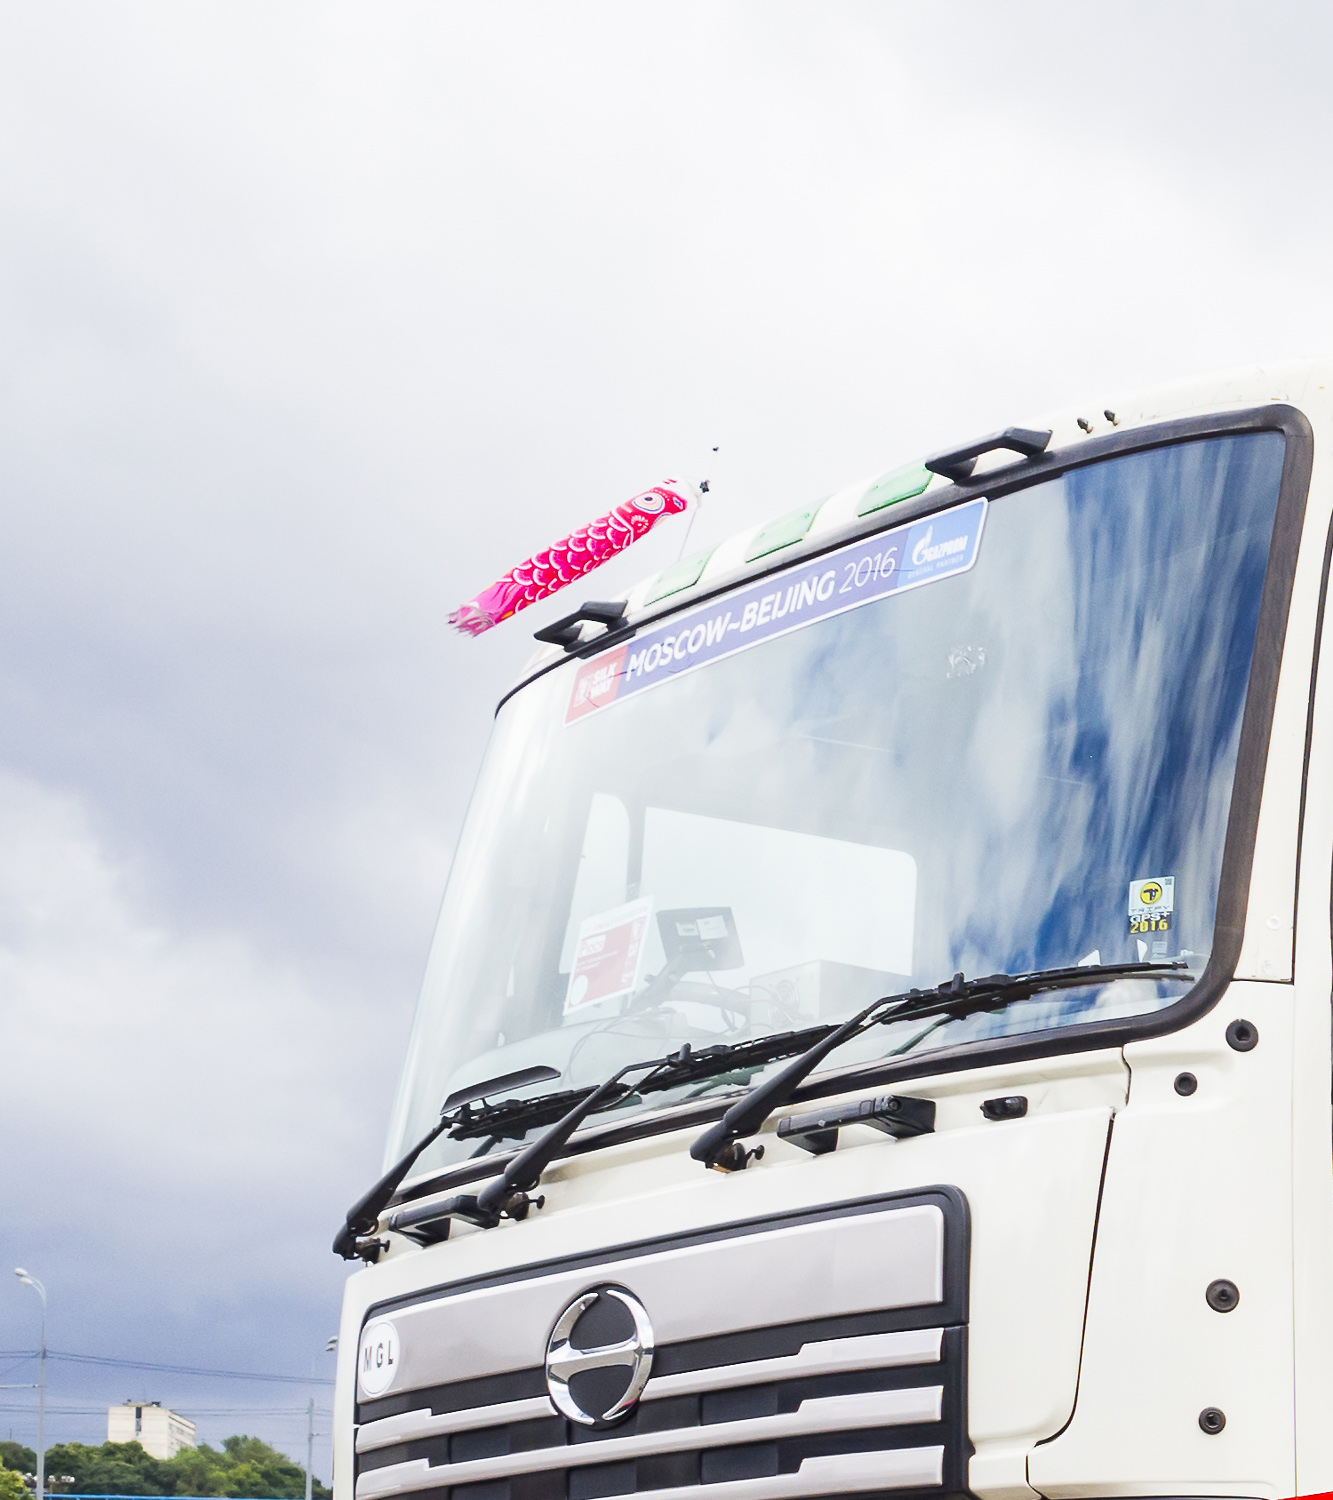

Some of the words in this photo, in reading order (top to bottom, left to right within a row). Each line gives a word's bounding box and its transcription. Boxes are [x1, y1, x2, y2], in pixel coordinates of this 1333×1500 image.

[838, 547, 898, 595] 2016
[1130, 919, 1168, 934] 2016
[363, 1340, 394, 1373] MGL
